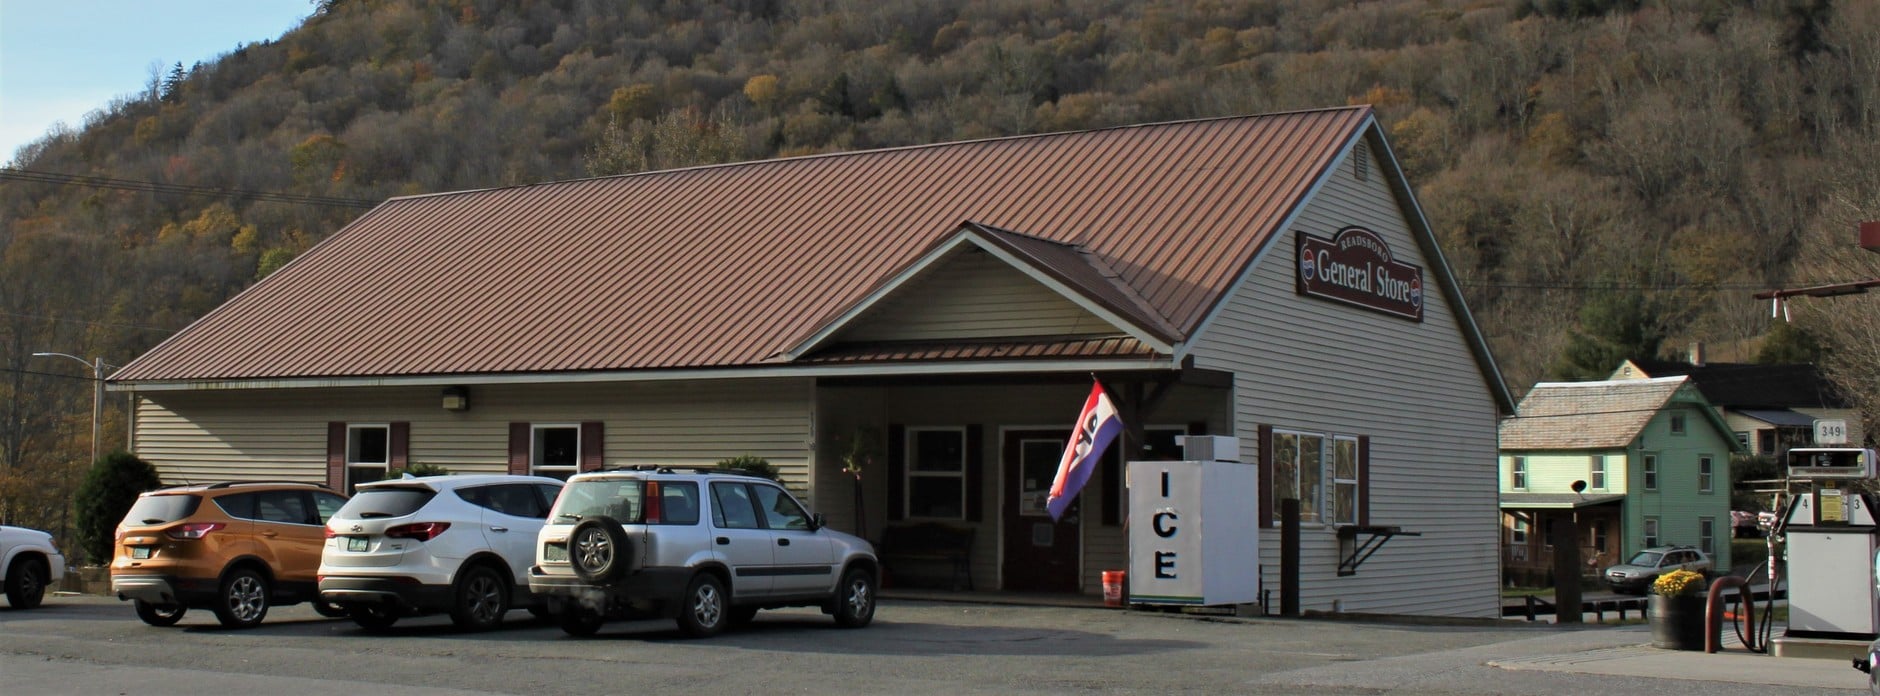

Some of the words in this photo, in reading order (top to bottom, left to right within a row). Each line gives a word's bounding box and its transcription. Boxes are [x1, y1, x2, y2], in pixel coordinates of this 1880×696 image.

[1341, 236, 1388, 262] READSBORO
[1317, 250, 1372, 292] General
[1377, 266, 1410, 302] Store
[1802, 499, 1808, 509] 4
[1854, 499, 1860, 510] 3
[1153, 471, 1177, 579] ICE
